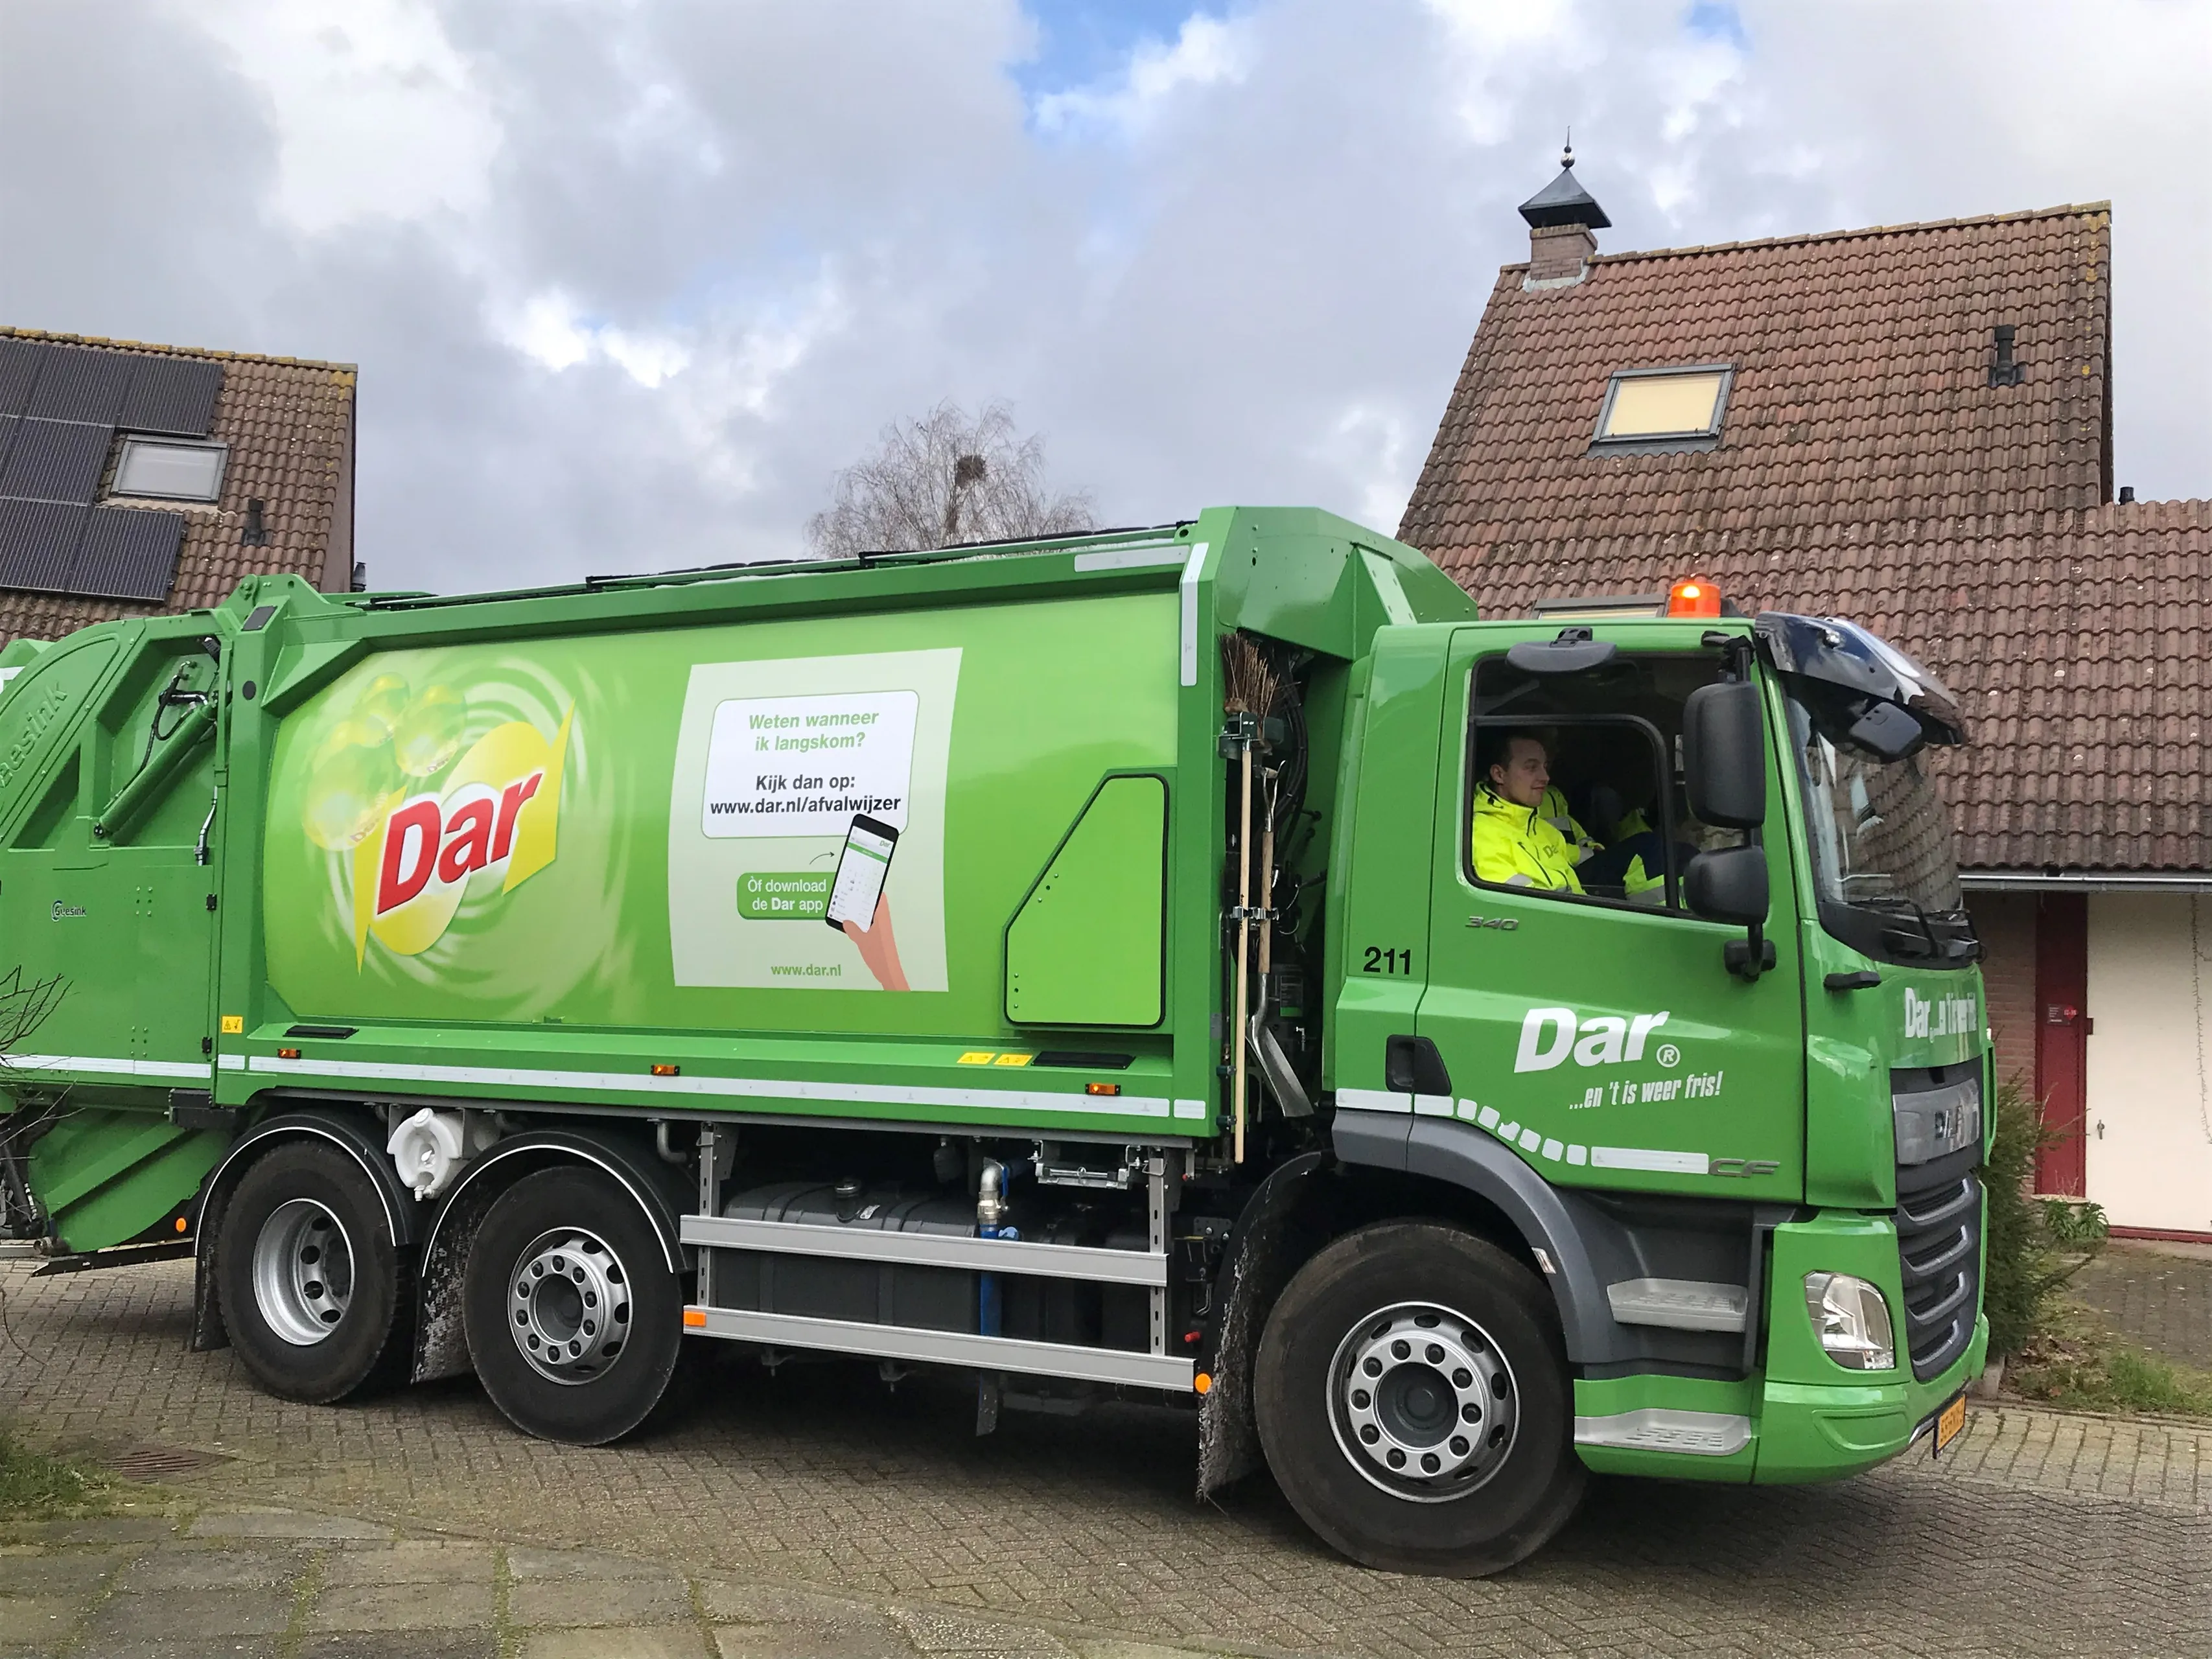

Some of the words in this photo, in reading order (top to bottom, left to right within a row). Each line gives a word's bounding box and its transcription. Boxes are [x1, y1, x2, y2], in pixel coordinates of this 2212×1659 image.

[749, 714, 800, 730] Weten
[806, 712, 879, 727] wanneer
[755, 736, 769, 751] ik
[774, 732, 866, 753] langskom?
[756, 774, 787, 793] Kijk
[793, 774, 823, 789] dan
[829, 776, 855, 791] op:
[710, 795, 902, 814] www.dar.nl/afvalwijzer
[377, 773, 543, 916] Dar
[747, 876, 762, 892] Òf
[765, 879, 826, 892] download
[752, 898, 767, 911] de
[771, 898, 795, 911] Dar
[799, 899, 824, 913] app
[1465, 916, 1519, 931] 340
[771, 964, 841, 976] www.dar.nl
[1363, 946, 1411, 975] 211
[1905, 987, 1931, 1038] Dar
[1514, 1007, 1670, 1073] Dar
[1622, 1080, 1637, 1104] is
[1642, 1079, 1681, 1102] weer
[1684, 1071, 1723, 1098] fris!
[1709, 1158, 1780, 1178] CF
